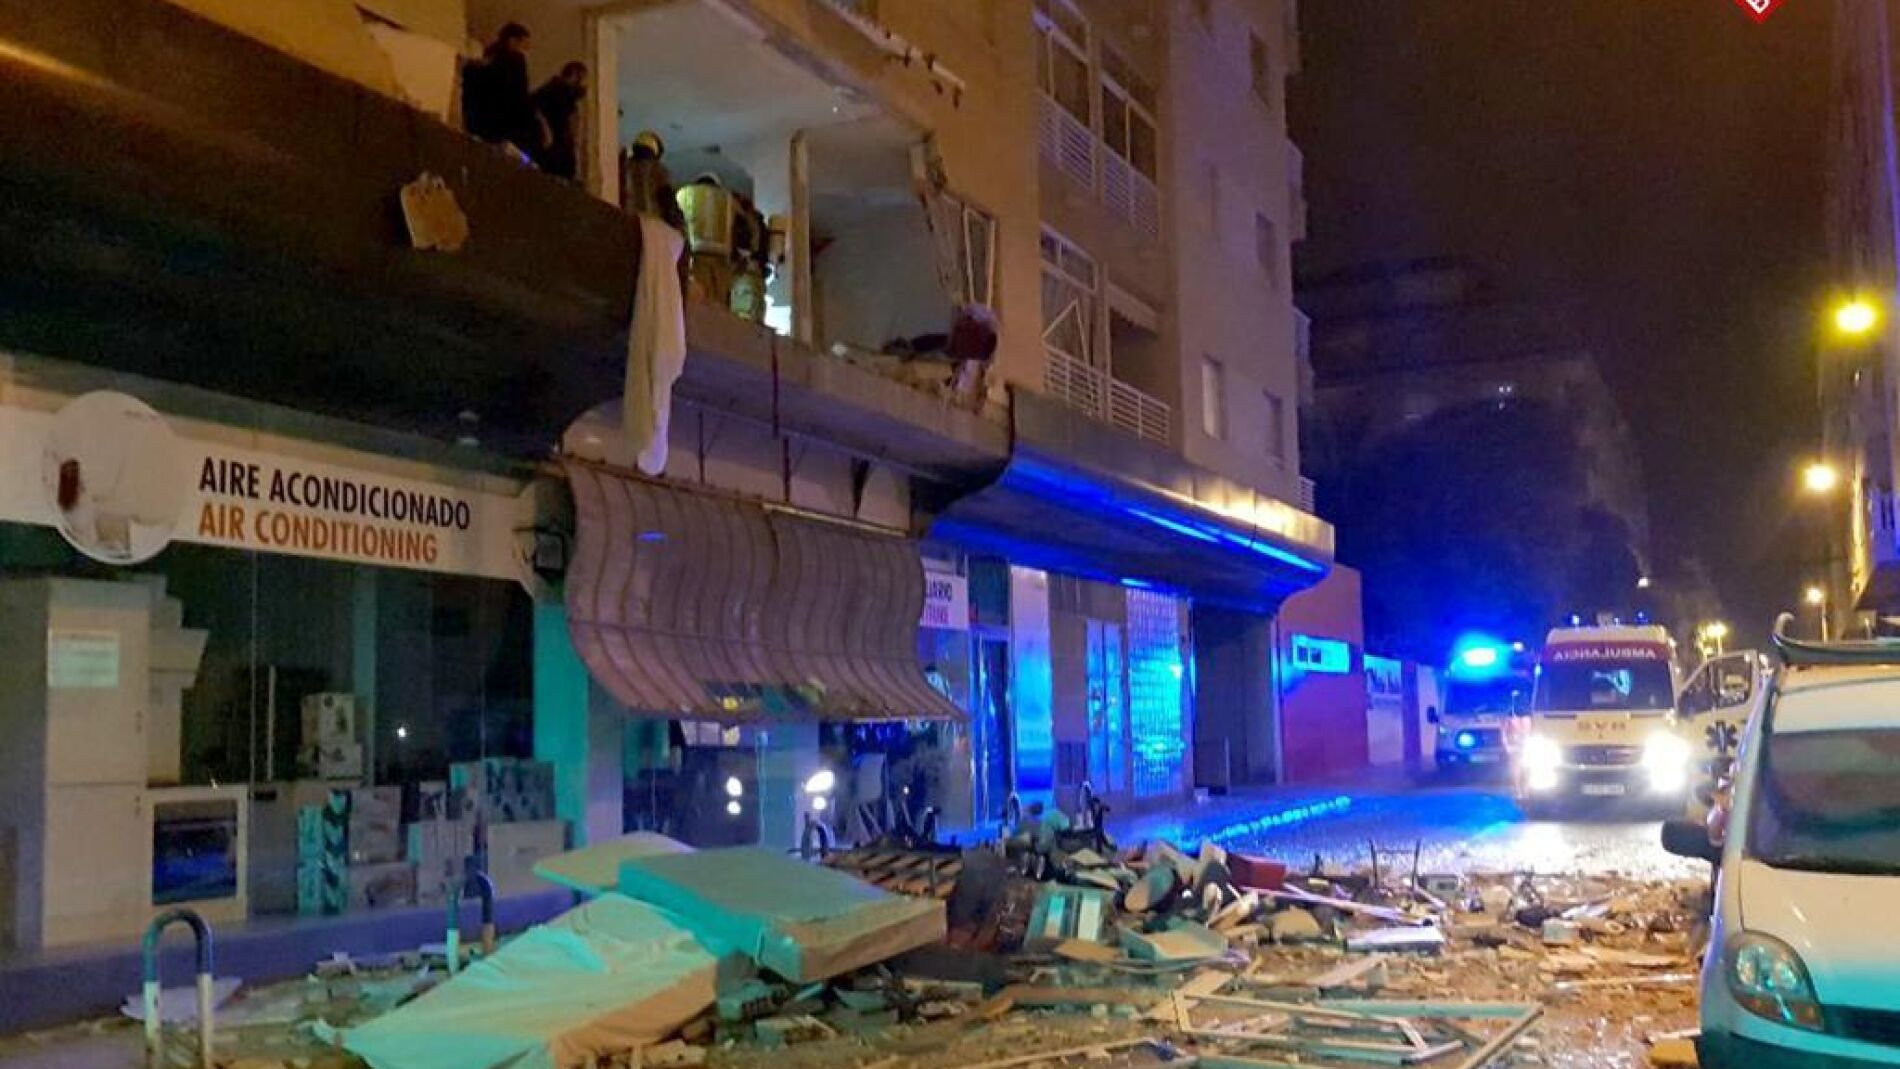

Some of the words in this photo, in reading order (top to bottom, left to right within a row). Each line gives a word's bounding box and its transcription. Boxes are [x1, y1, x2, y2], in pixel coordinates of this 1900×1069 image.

[199, 457, 260, 500] AIRE
[268, 468, 470, 530] ACONDICIONADO
[199, 503, 246, 541] AIR
[254, 510, 437, 563] CONDITIONING
